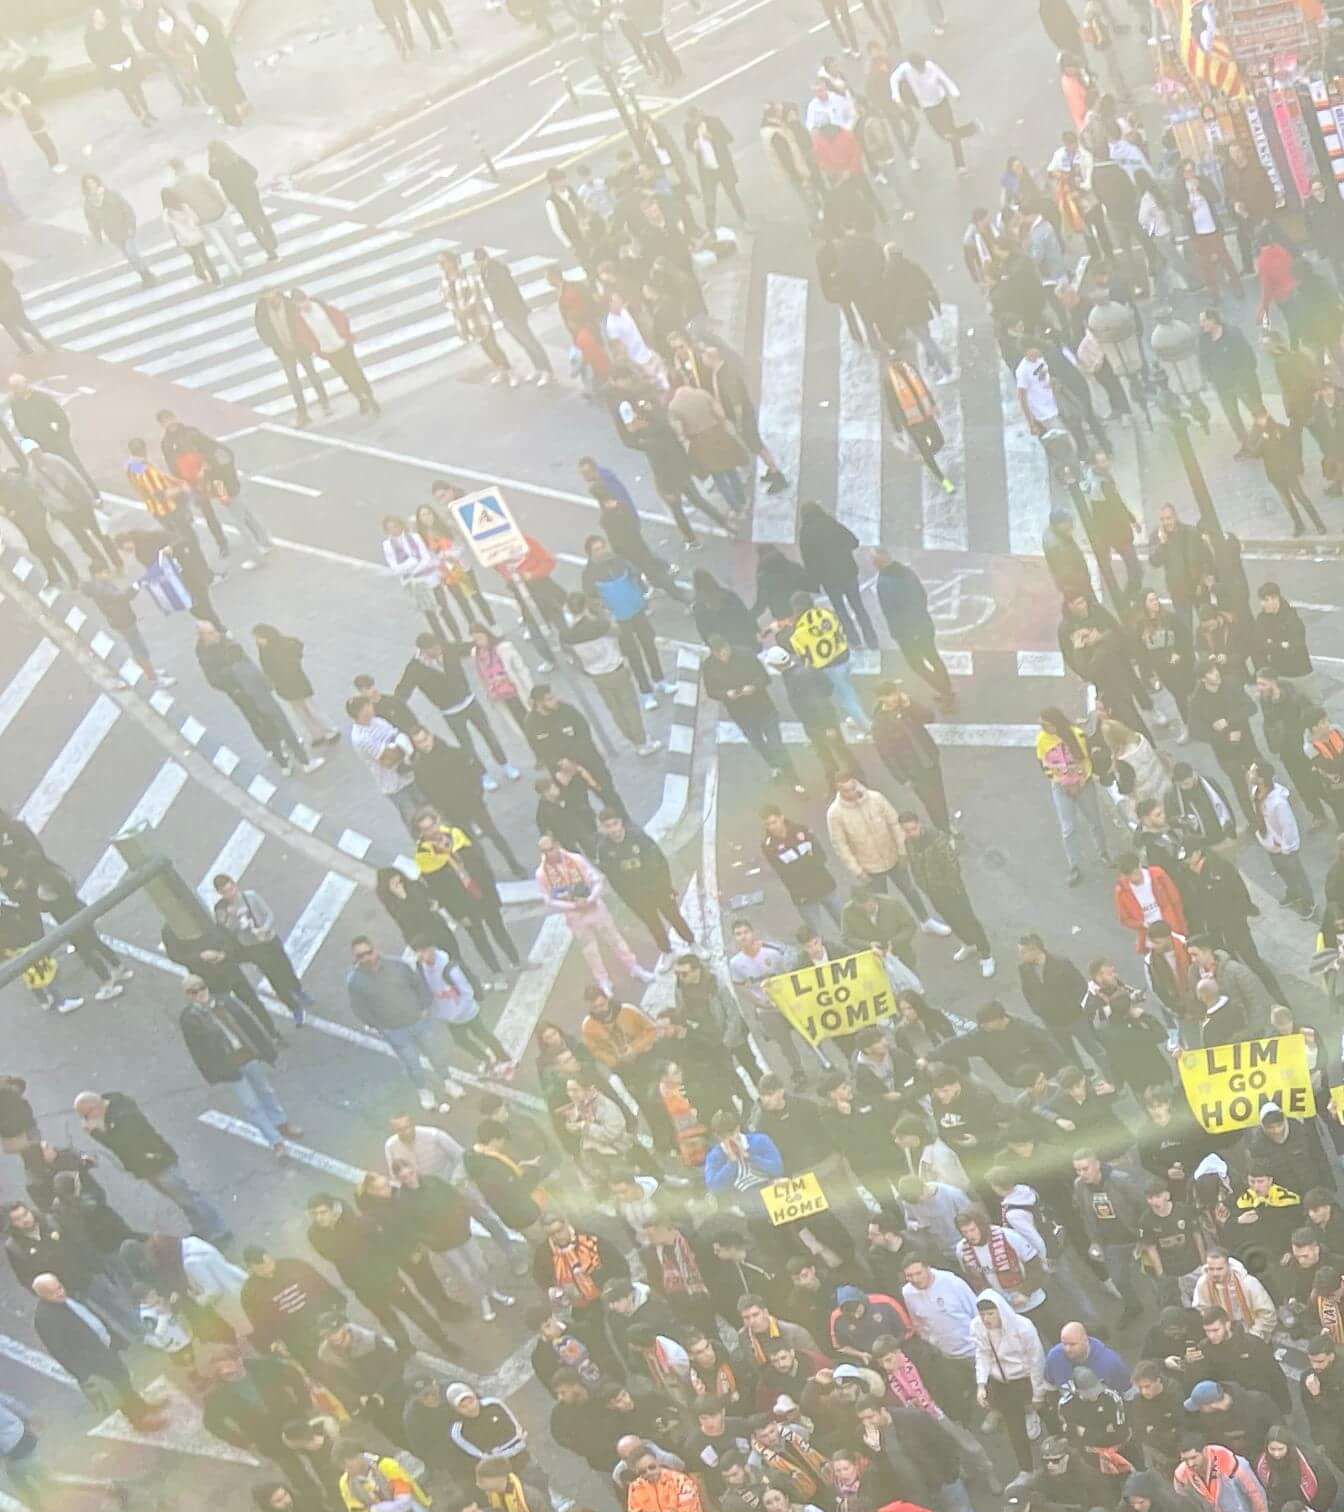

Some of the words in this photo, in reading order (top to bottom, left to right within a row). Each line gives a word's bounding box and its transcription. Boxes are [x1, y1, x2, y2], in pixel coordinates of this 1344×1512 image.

[790, 961, 859, 998] LIM
[816, 986, 851, 1006] GO
[1205, 1036, 1278, 1077] LIM
[1227, 1071, 1266, 1092] GO
[773, 1197, 823, 1222] HOME
